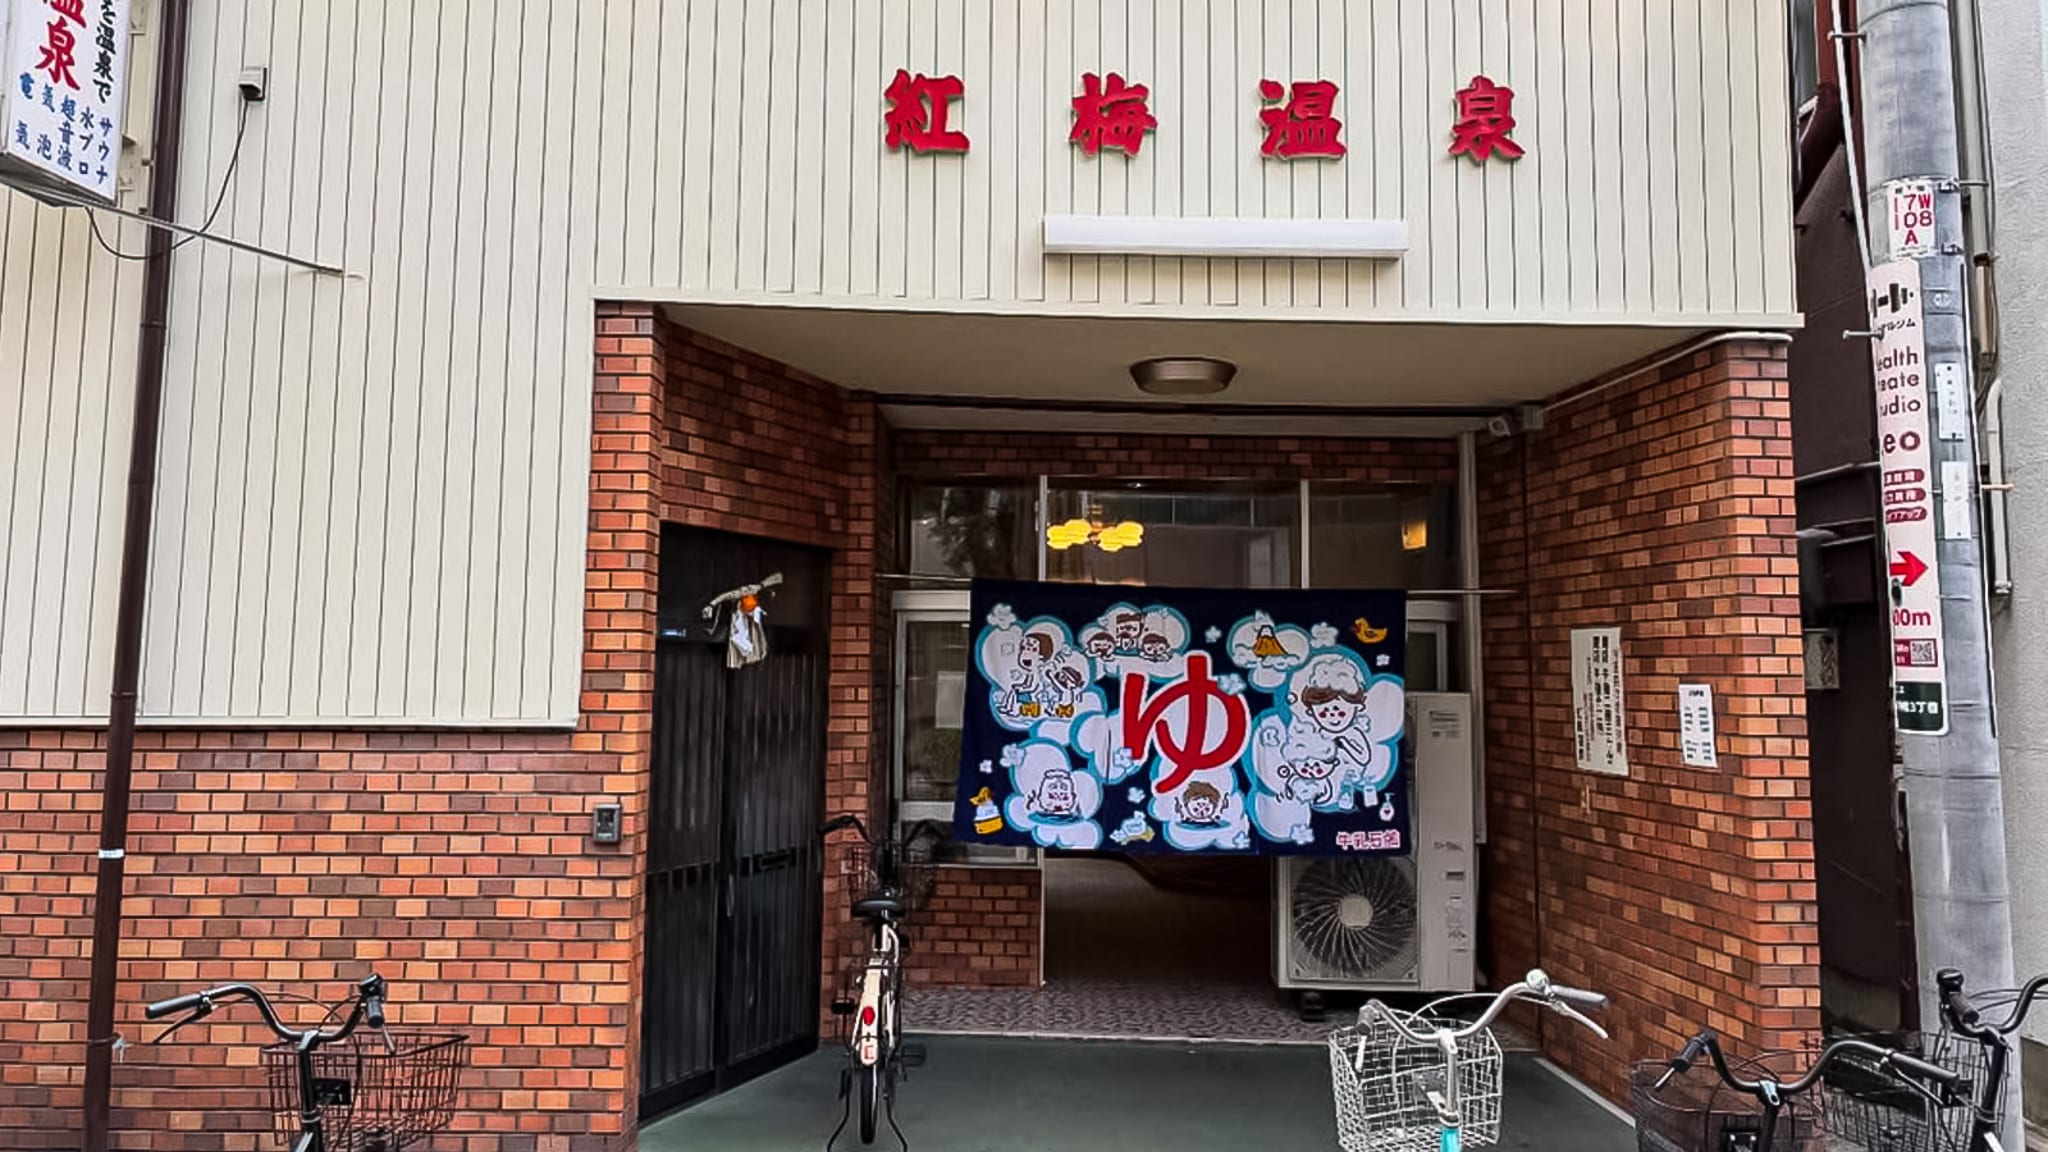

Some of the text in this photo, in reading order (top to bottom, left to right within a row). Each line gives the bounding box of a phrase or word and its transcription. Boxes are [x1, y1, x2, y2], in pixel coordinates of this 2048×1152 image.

[58, 94, 76, 171] 超音波
[883, 68, 1526, 160] 紅梅温泉
[96, 117, 113, 184] サウナ
[1904, 229, 1919, 246] A
[1882, 431, 1921, 455] eo
[1123, 655, 1247, 794] ゆ
